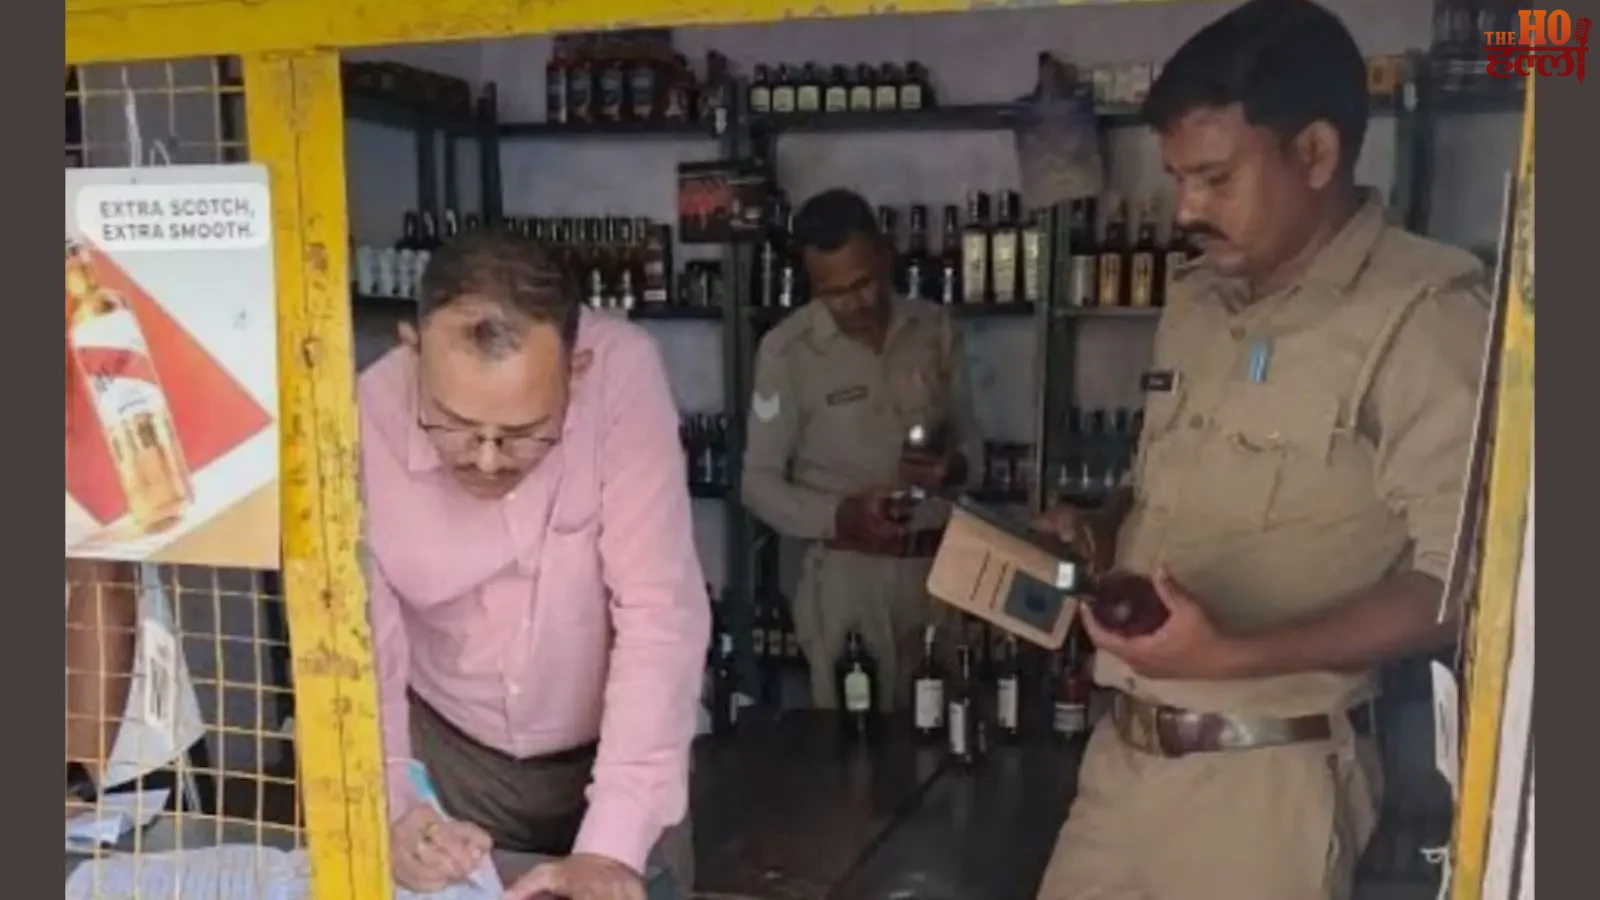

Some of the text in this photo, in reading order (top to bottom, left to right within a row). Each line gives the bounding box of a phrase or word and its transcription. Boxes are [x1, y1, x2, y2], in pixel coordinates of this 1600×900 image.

[99, 197, 256, 219] EXTRA SCOTCH,
[102, 220, 254, 241] EXTRA SMOOTH.
